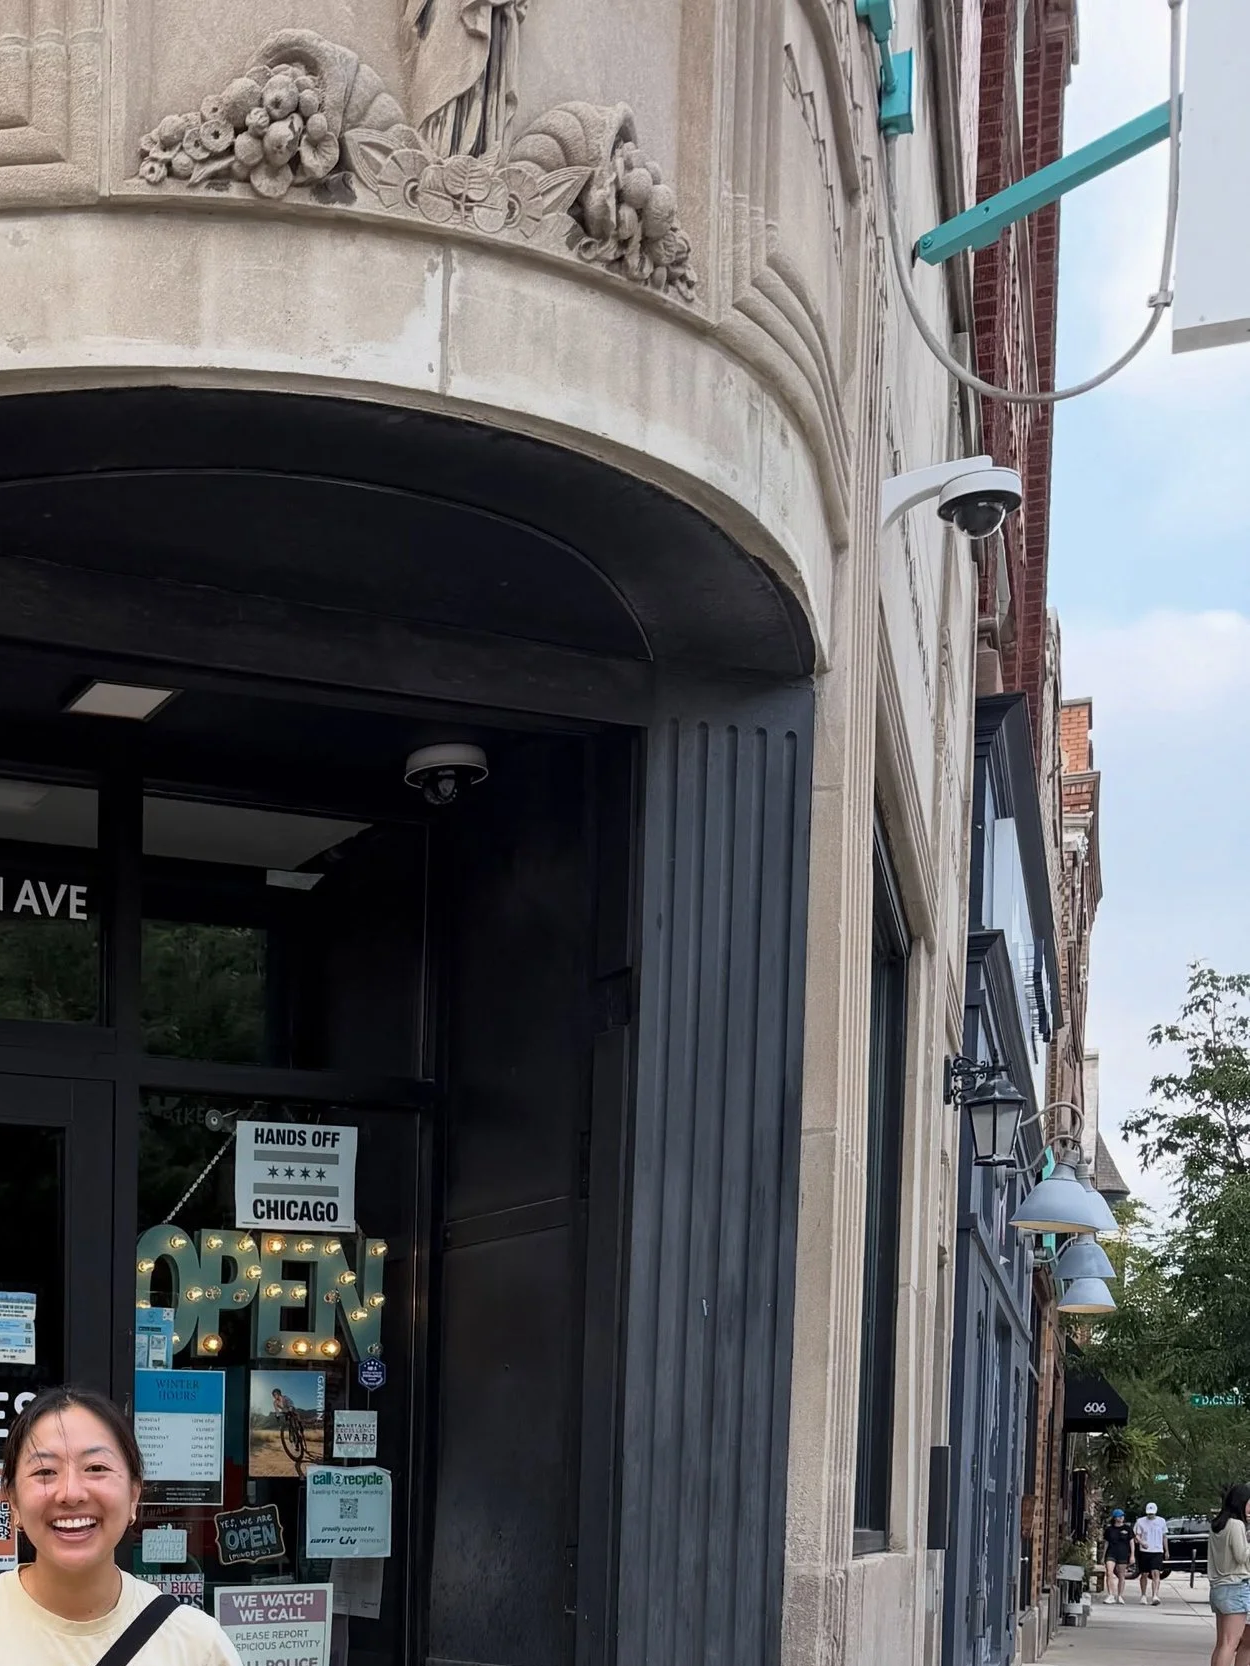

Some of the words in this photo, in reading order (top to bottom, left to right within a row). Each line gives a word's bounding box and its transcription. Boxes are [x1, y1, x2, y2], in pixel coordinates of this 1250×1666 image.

[14, 880, 88, 921] AVE
[254, 1127, 307, 1147] HANDS
[311, 1130, 341, 1149] OFF
[252, 1198, 339, 1222] CHICAGO
[136, 1224, 385, 1362] OPEN
[156, 1379, 200, 1390] WINTER
[158, 1390, 197, 1401] HOURS
[317, 1375, 325, 1421] GARMIN
[1084, 1402, 1106, 1413] 606
[336, 1433, 376, 1441] AWARD
[240, 1516, 253, 1525] WE
[256, 1514, 273, 1523] ARE
[225, 1523, 277, 1551] OPEN
[171, 1582, 203, 1594] BIKE
[232, 1595, 258, 1608] WE
[261, 1593, 314, 1607] WATCH
[239, 1609, 264, 1622] WE
[267, 1608, 306, 1620] CALL
[235, 1630, 270, 1641] PLEASE
[271, 1629, 310, 1639] REPORT
[234, 1641, 277, 1651] SPICIOUS
[278, 1640, 321, 1649] ACTIVITY
